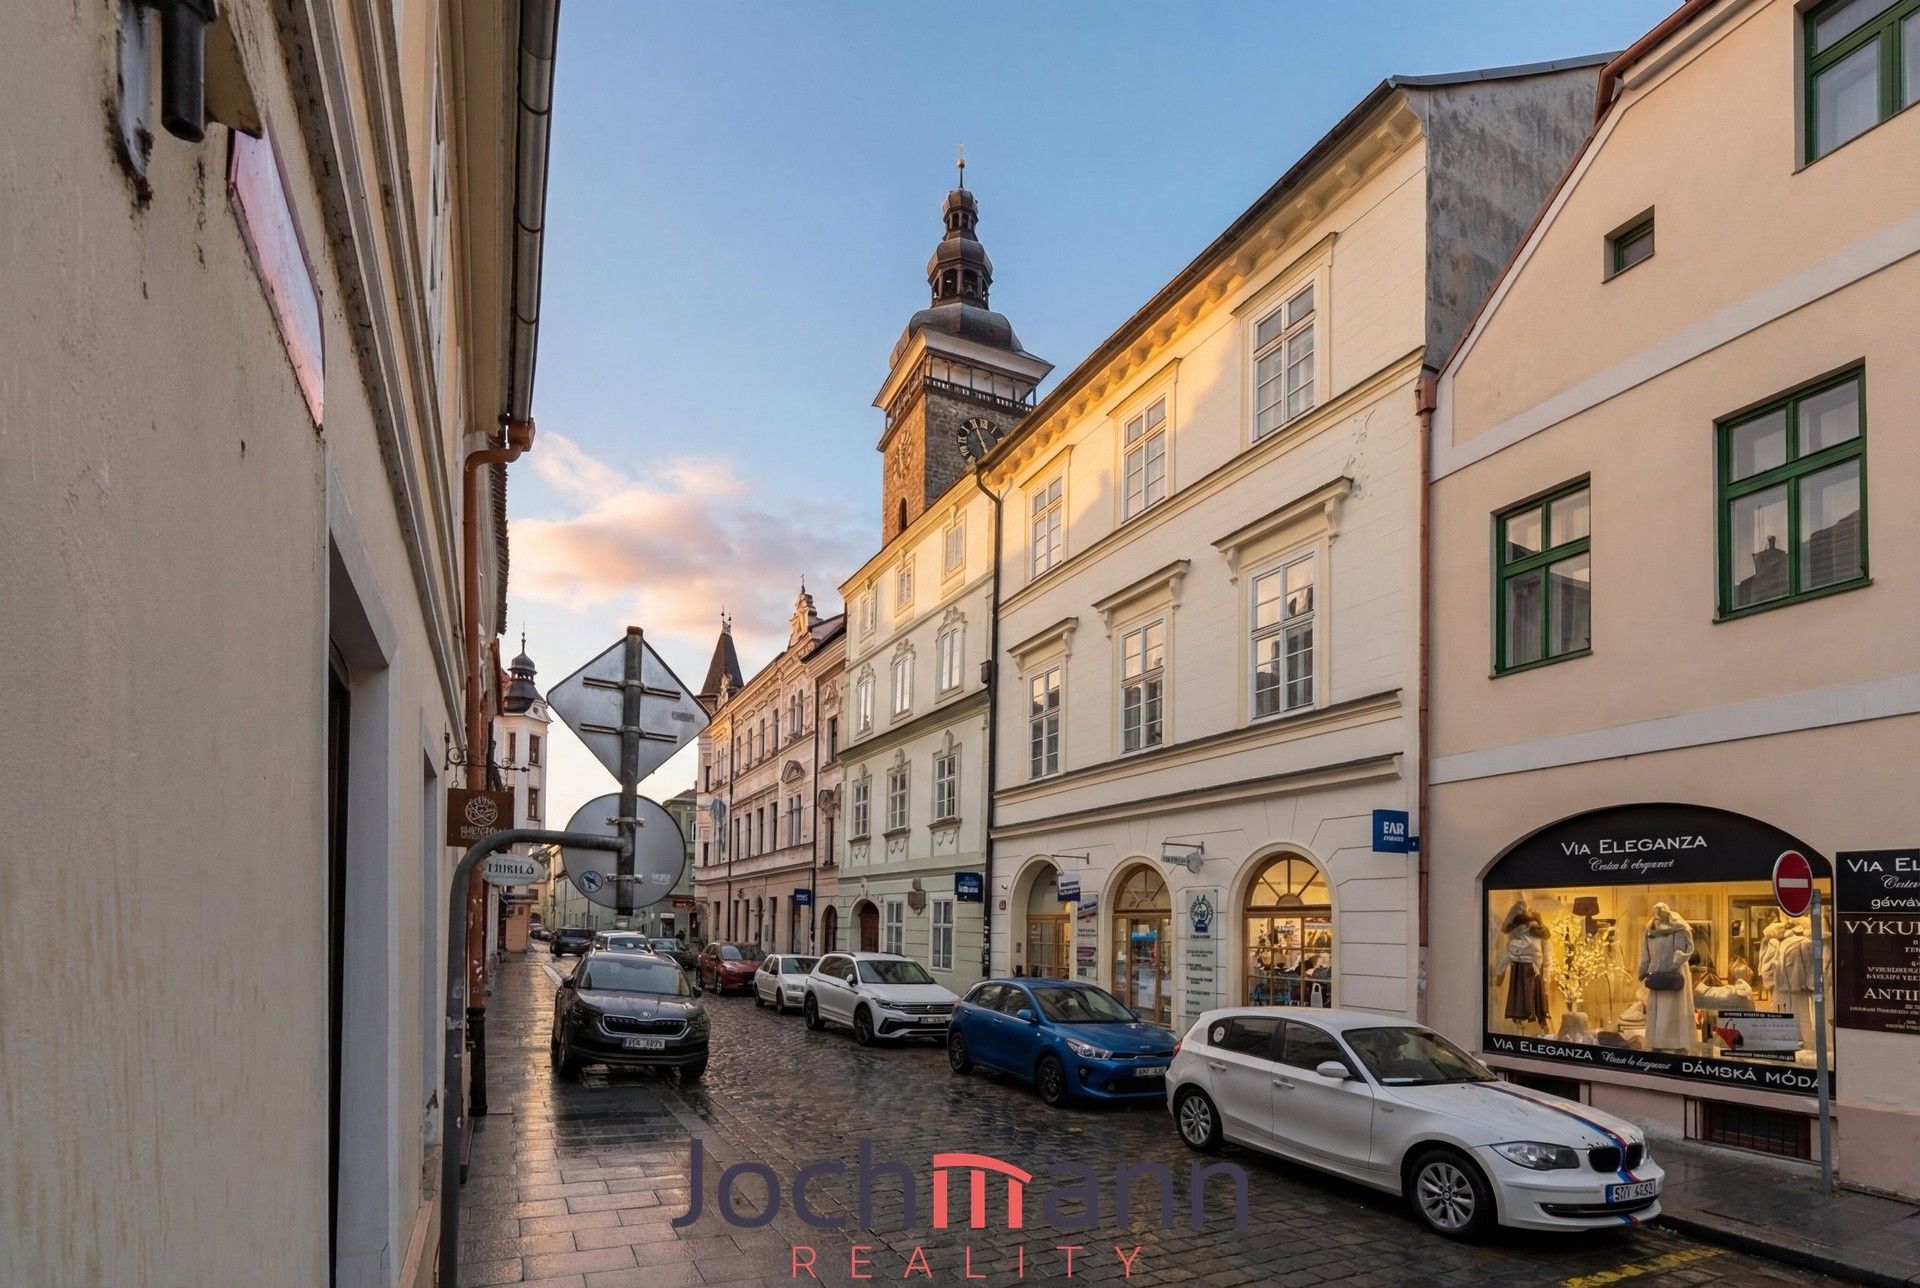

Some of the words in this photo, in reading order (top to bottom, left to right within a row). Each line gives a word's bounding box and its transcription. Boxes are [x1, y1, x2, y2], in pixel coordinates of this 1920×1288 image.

[1383, 821, 1404, 835] EAR
[1561, 841, 1591, 856] VIA
[1599, 836, 1708, 854] ELEGANZA
[1847, 859, 1883, 872] VIA
[1493, 1037, 1514, 1050] VIA
[1520, 1041, 1593, 1060] ELEGANZA
[1682, 1060, 1757, 1081] DÁMSKÁ
